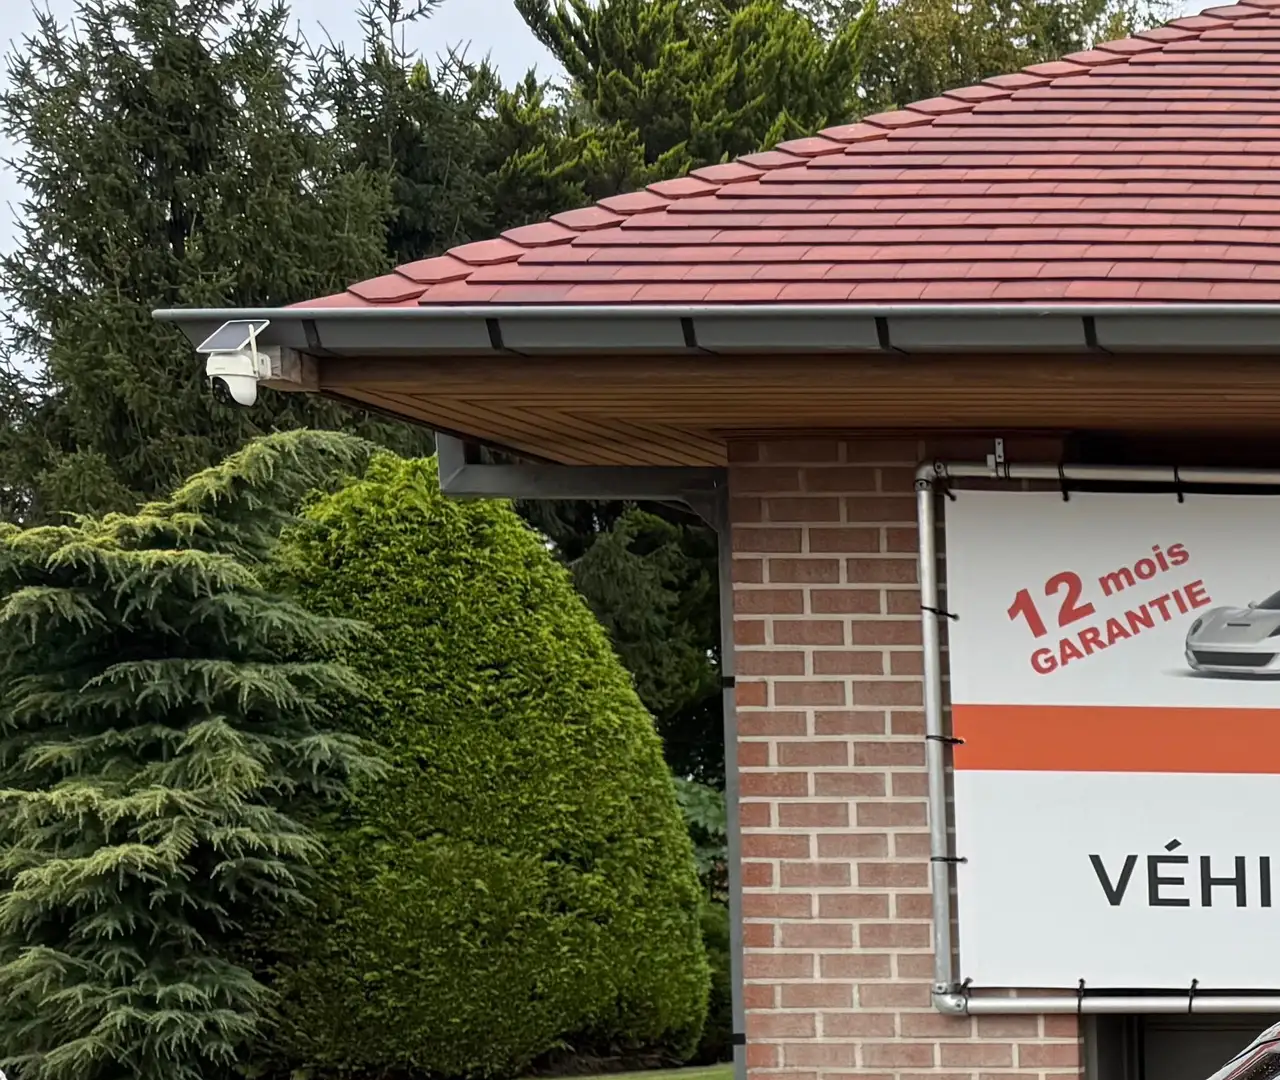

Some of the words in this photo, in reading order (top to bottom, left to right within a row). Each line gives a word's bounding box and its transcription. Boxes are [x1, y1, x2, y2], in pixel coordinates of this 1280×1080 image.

[1007, 571, 1095, 638] 12
[1099, 543, 1190, 597] mois
[1031, 579, 1211, 675] GARANTIE
